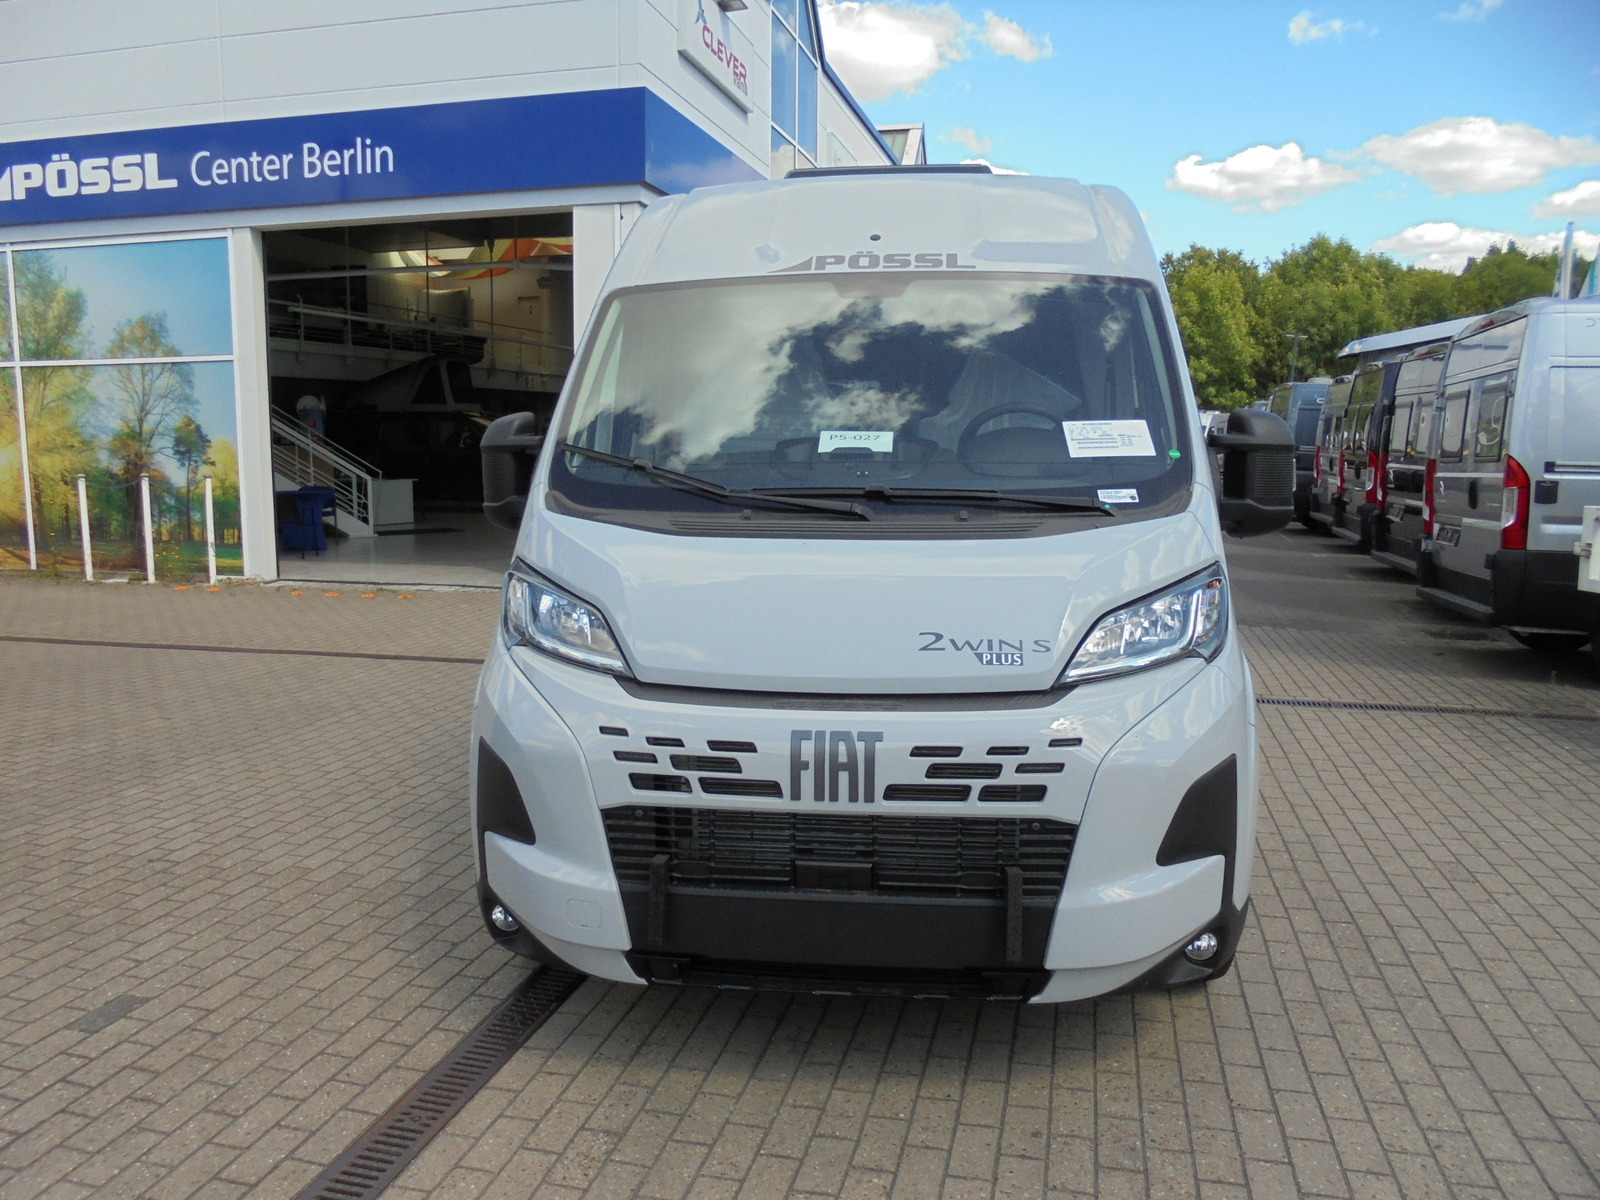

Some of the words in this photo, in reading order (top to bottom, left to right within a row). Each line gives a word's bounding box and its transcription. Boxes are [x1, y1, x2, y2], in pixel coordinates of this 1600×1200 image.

[702, 24, 747, 81] CLEVER
[12, 153, 178, 200] PÖSSL
[190, 150, 293, 186] Center
[303, 136, 394, 178] Berlin
[814, 251, 976, 271] PÖSSL
[982, 653, 1022, 666] PLUS
[790, 730, 884, 803] FIAT
